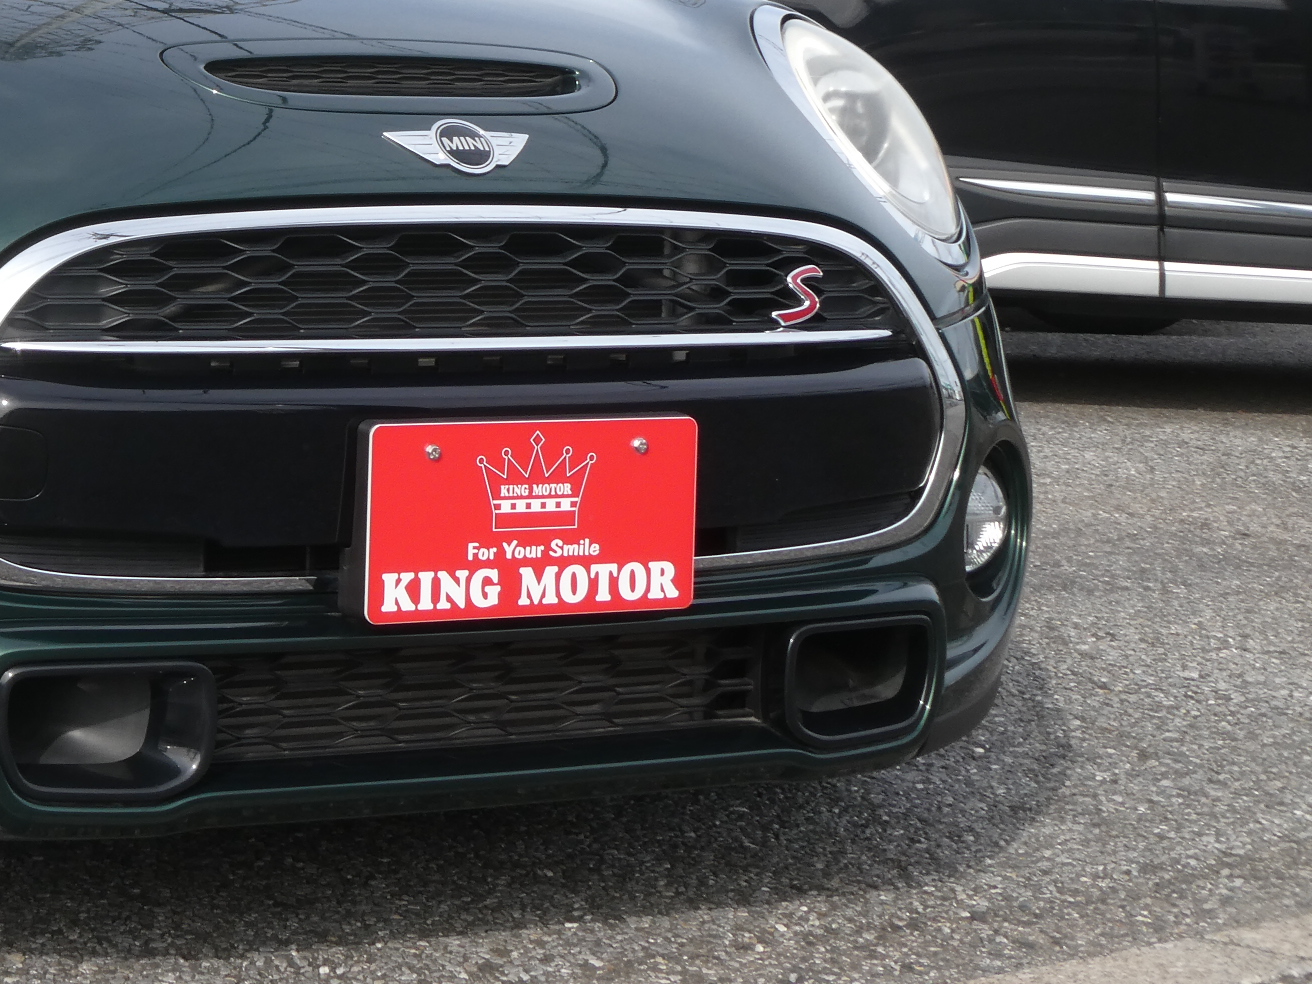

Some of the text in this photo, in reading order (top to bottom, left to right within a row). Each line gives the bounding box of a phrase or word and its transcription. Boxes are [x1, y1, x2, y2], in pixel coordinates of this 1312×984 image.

[441, 136, 490, 151] MINI
[500, 483, 572, 497] KING MOTOR
[467, 538, 600, 561] For Your Smile
[380, 560, 680, 613] KING MOTOR
